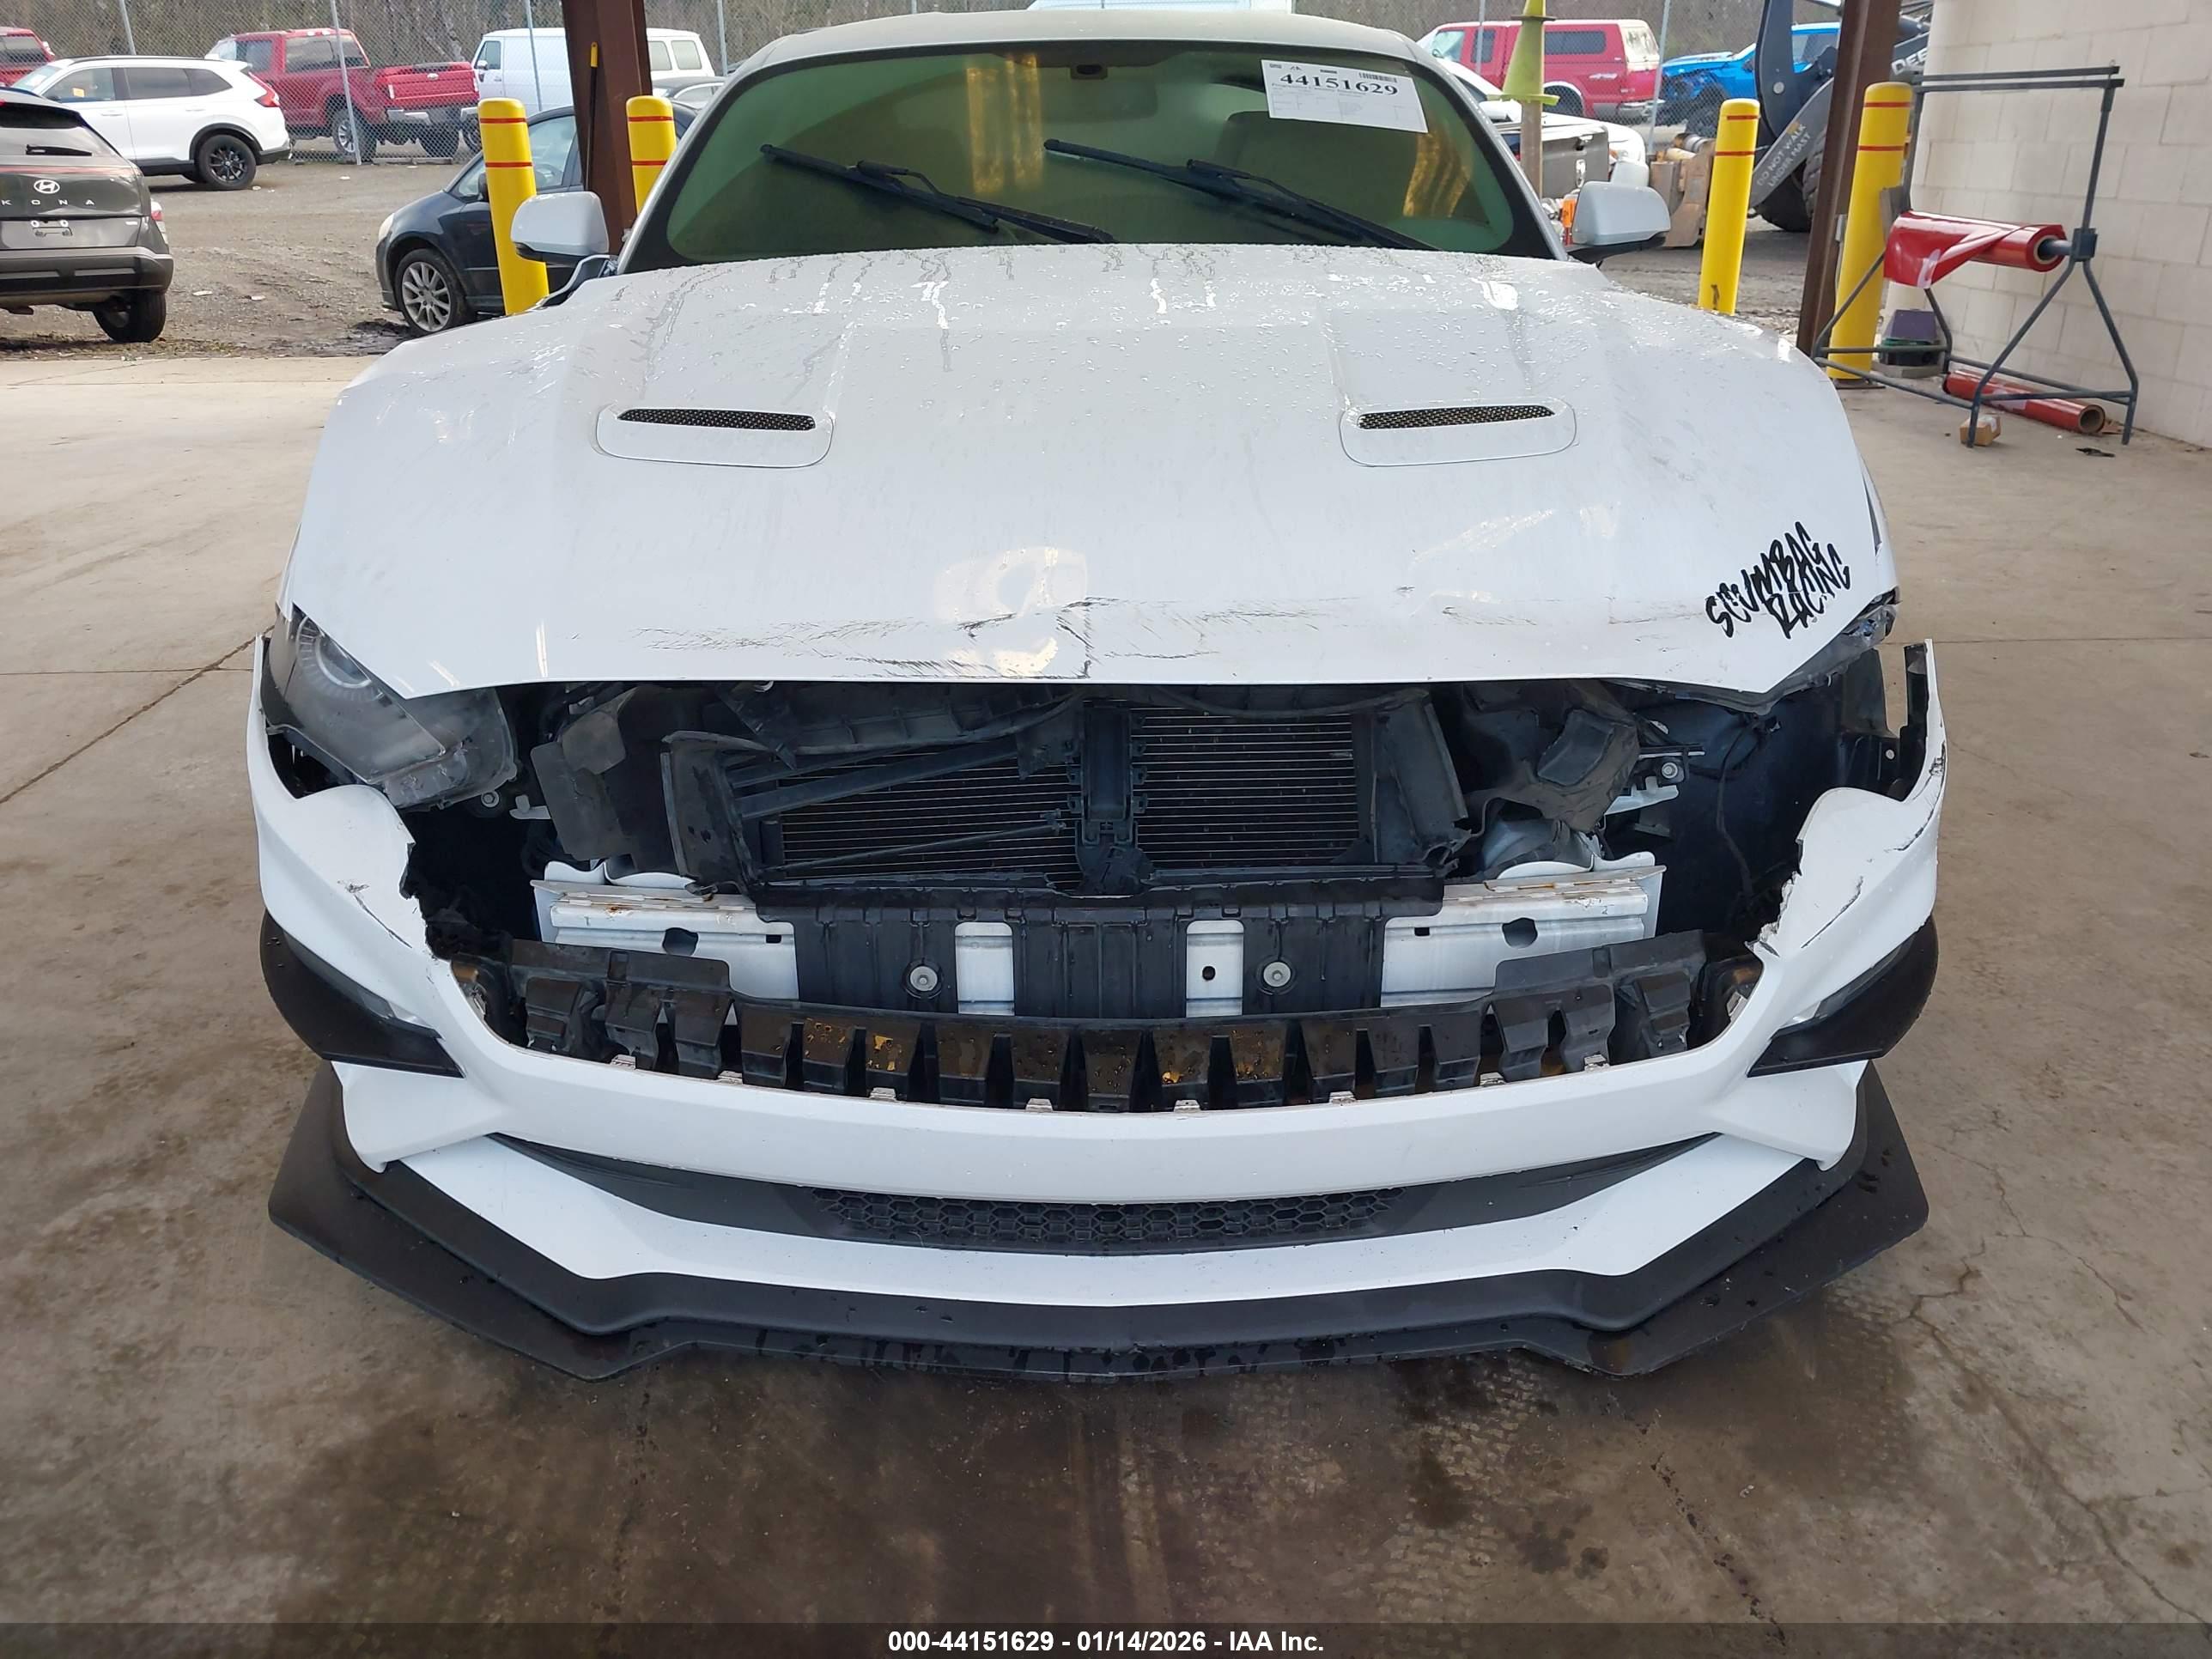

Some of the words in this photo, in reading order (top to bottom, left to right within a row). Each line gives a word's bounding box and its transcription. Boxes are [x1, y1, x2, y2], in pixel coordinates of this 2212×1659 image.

[1280, 74, 1398, 95] 44151629
[1768, 150, 1784, 171] NOT
[1784, 124, 1807, 149] WALK
[1768, 157, 1794, 186] UNDER
[1791, 131, 1811, 156] MAST
